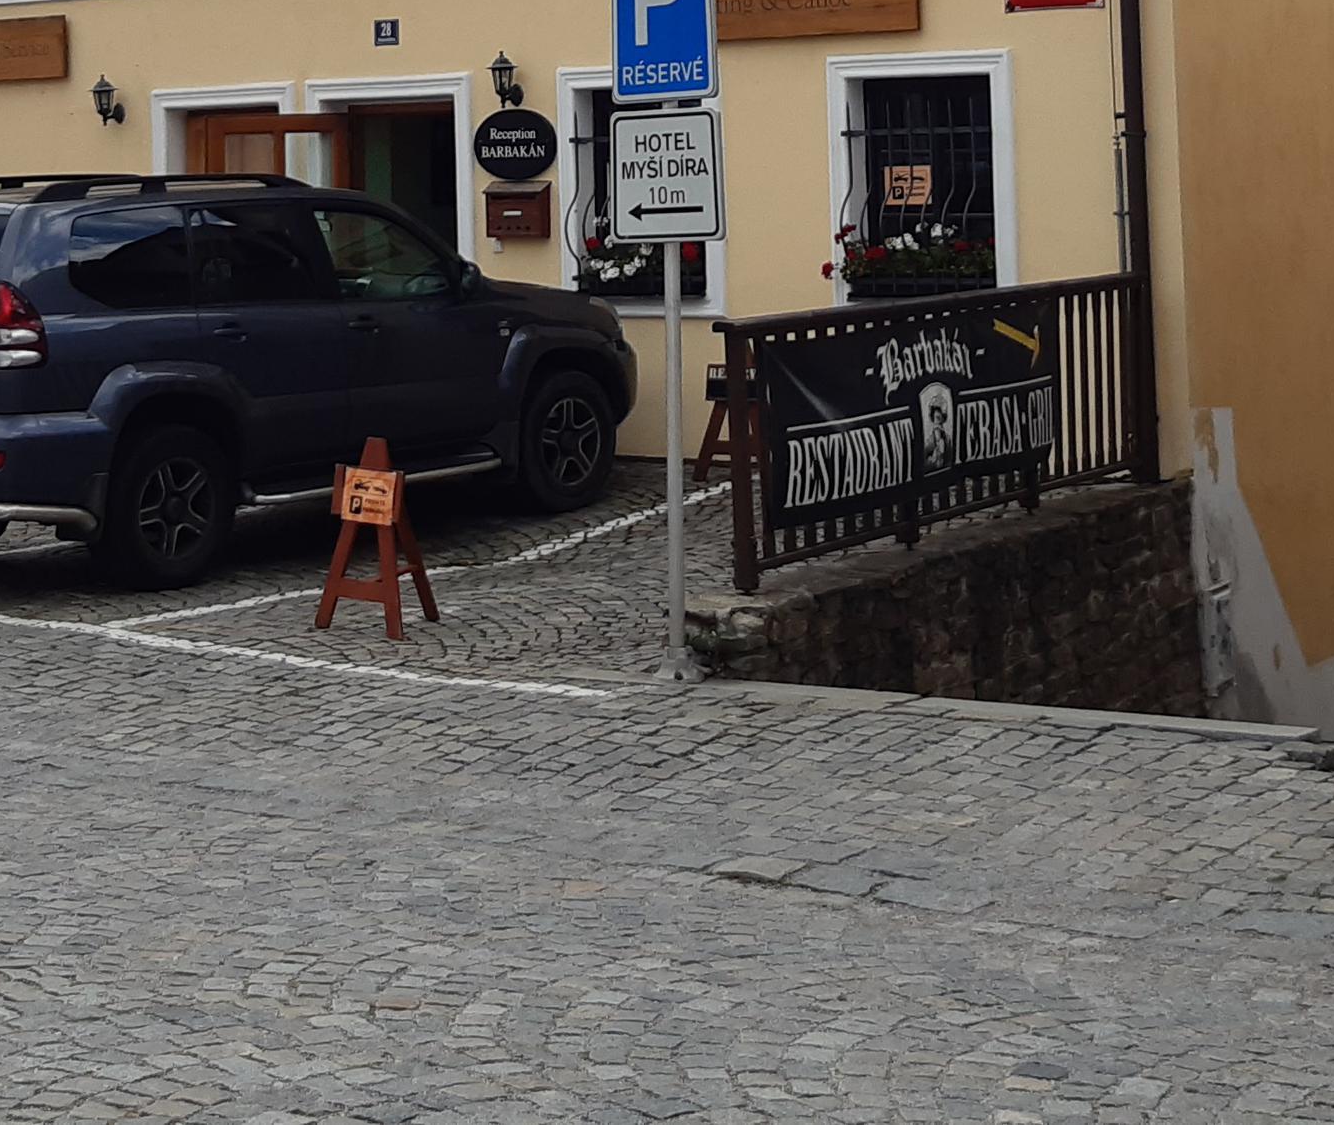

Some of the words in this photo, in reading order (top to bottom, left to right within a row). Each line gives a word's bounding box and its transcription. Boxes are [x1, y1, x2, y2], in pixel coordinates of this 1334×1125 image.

[380, 22, 392, 36] 28
[622, 56, 705, 87] RÉSERVÉ
[489, 127, 537, 143] Reception
[634, 131, 696, 154] HOTEL
[480, 142, 546, 158] BARBAKÁN
[621, 155, 664, 181] MYŠÍ
[668, 153, 709, 177] DÍRA
[783, 417, 915, 509] RESTAURANT
[954, 393, 1023, 465] TERASA
